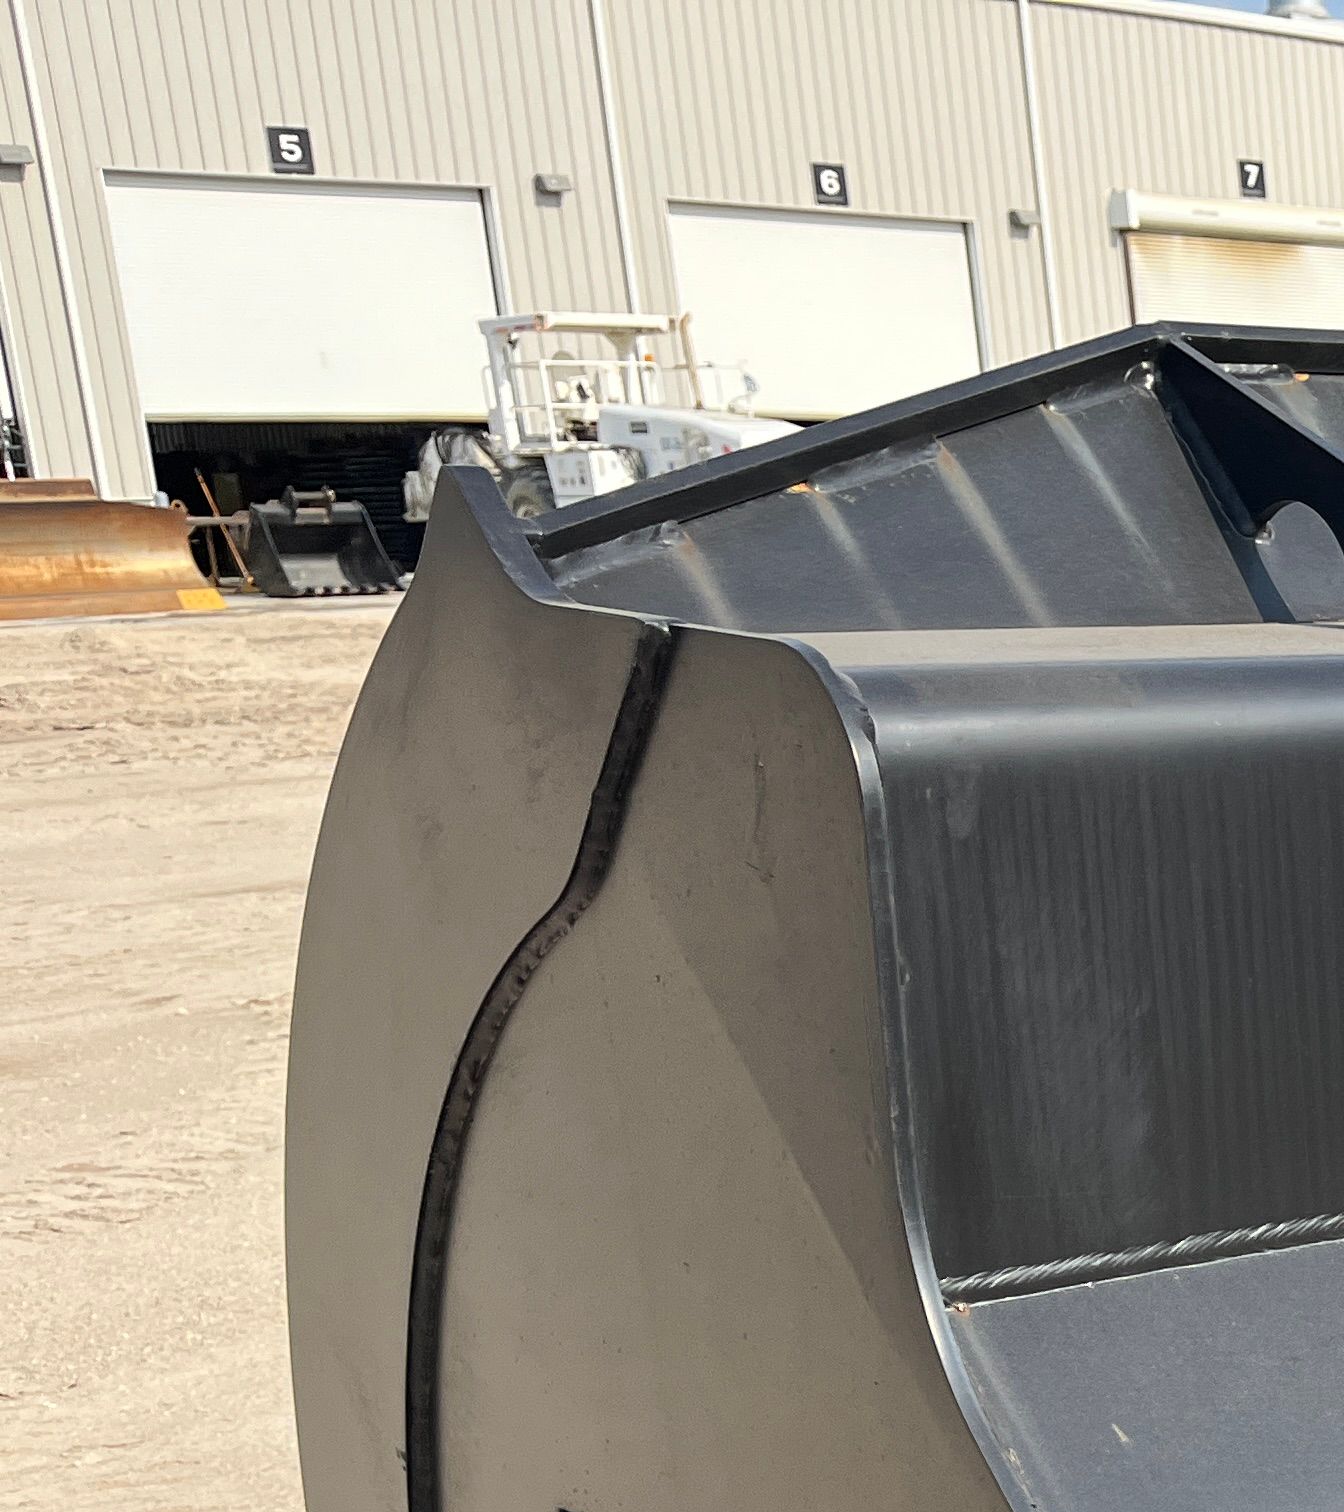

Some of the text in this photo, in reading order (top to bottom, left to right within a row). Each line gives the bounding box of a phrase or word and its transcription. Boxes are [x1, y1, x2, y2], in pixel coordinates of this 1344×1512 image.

[278, 133, 302, 162] 5
[819, 168, 841, 196] 6
[1243, 163, 1260, 189] 7
